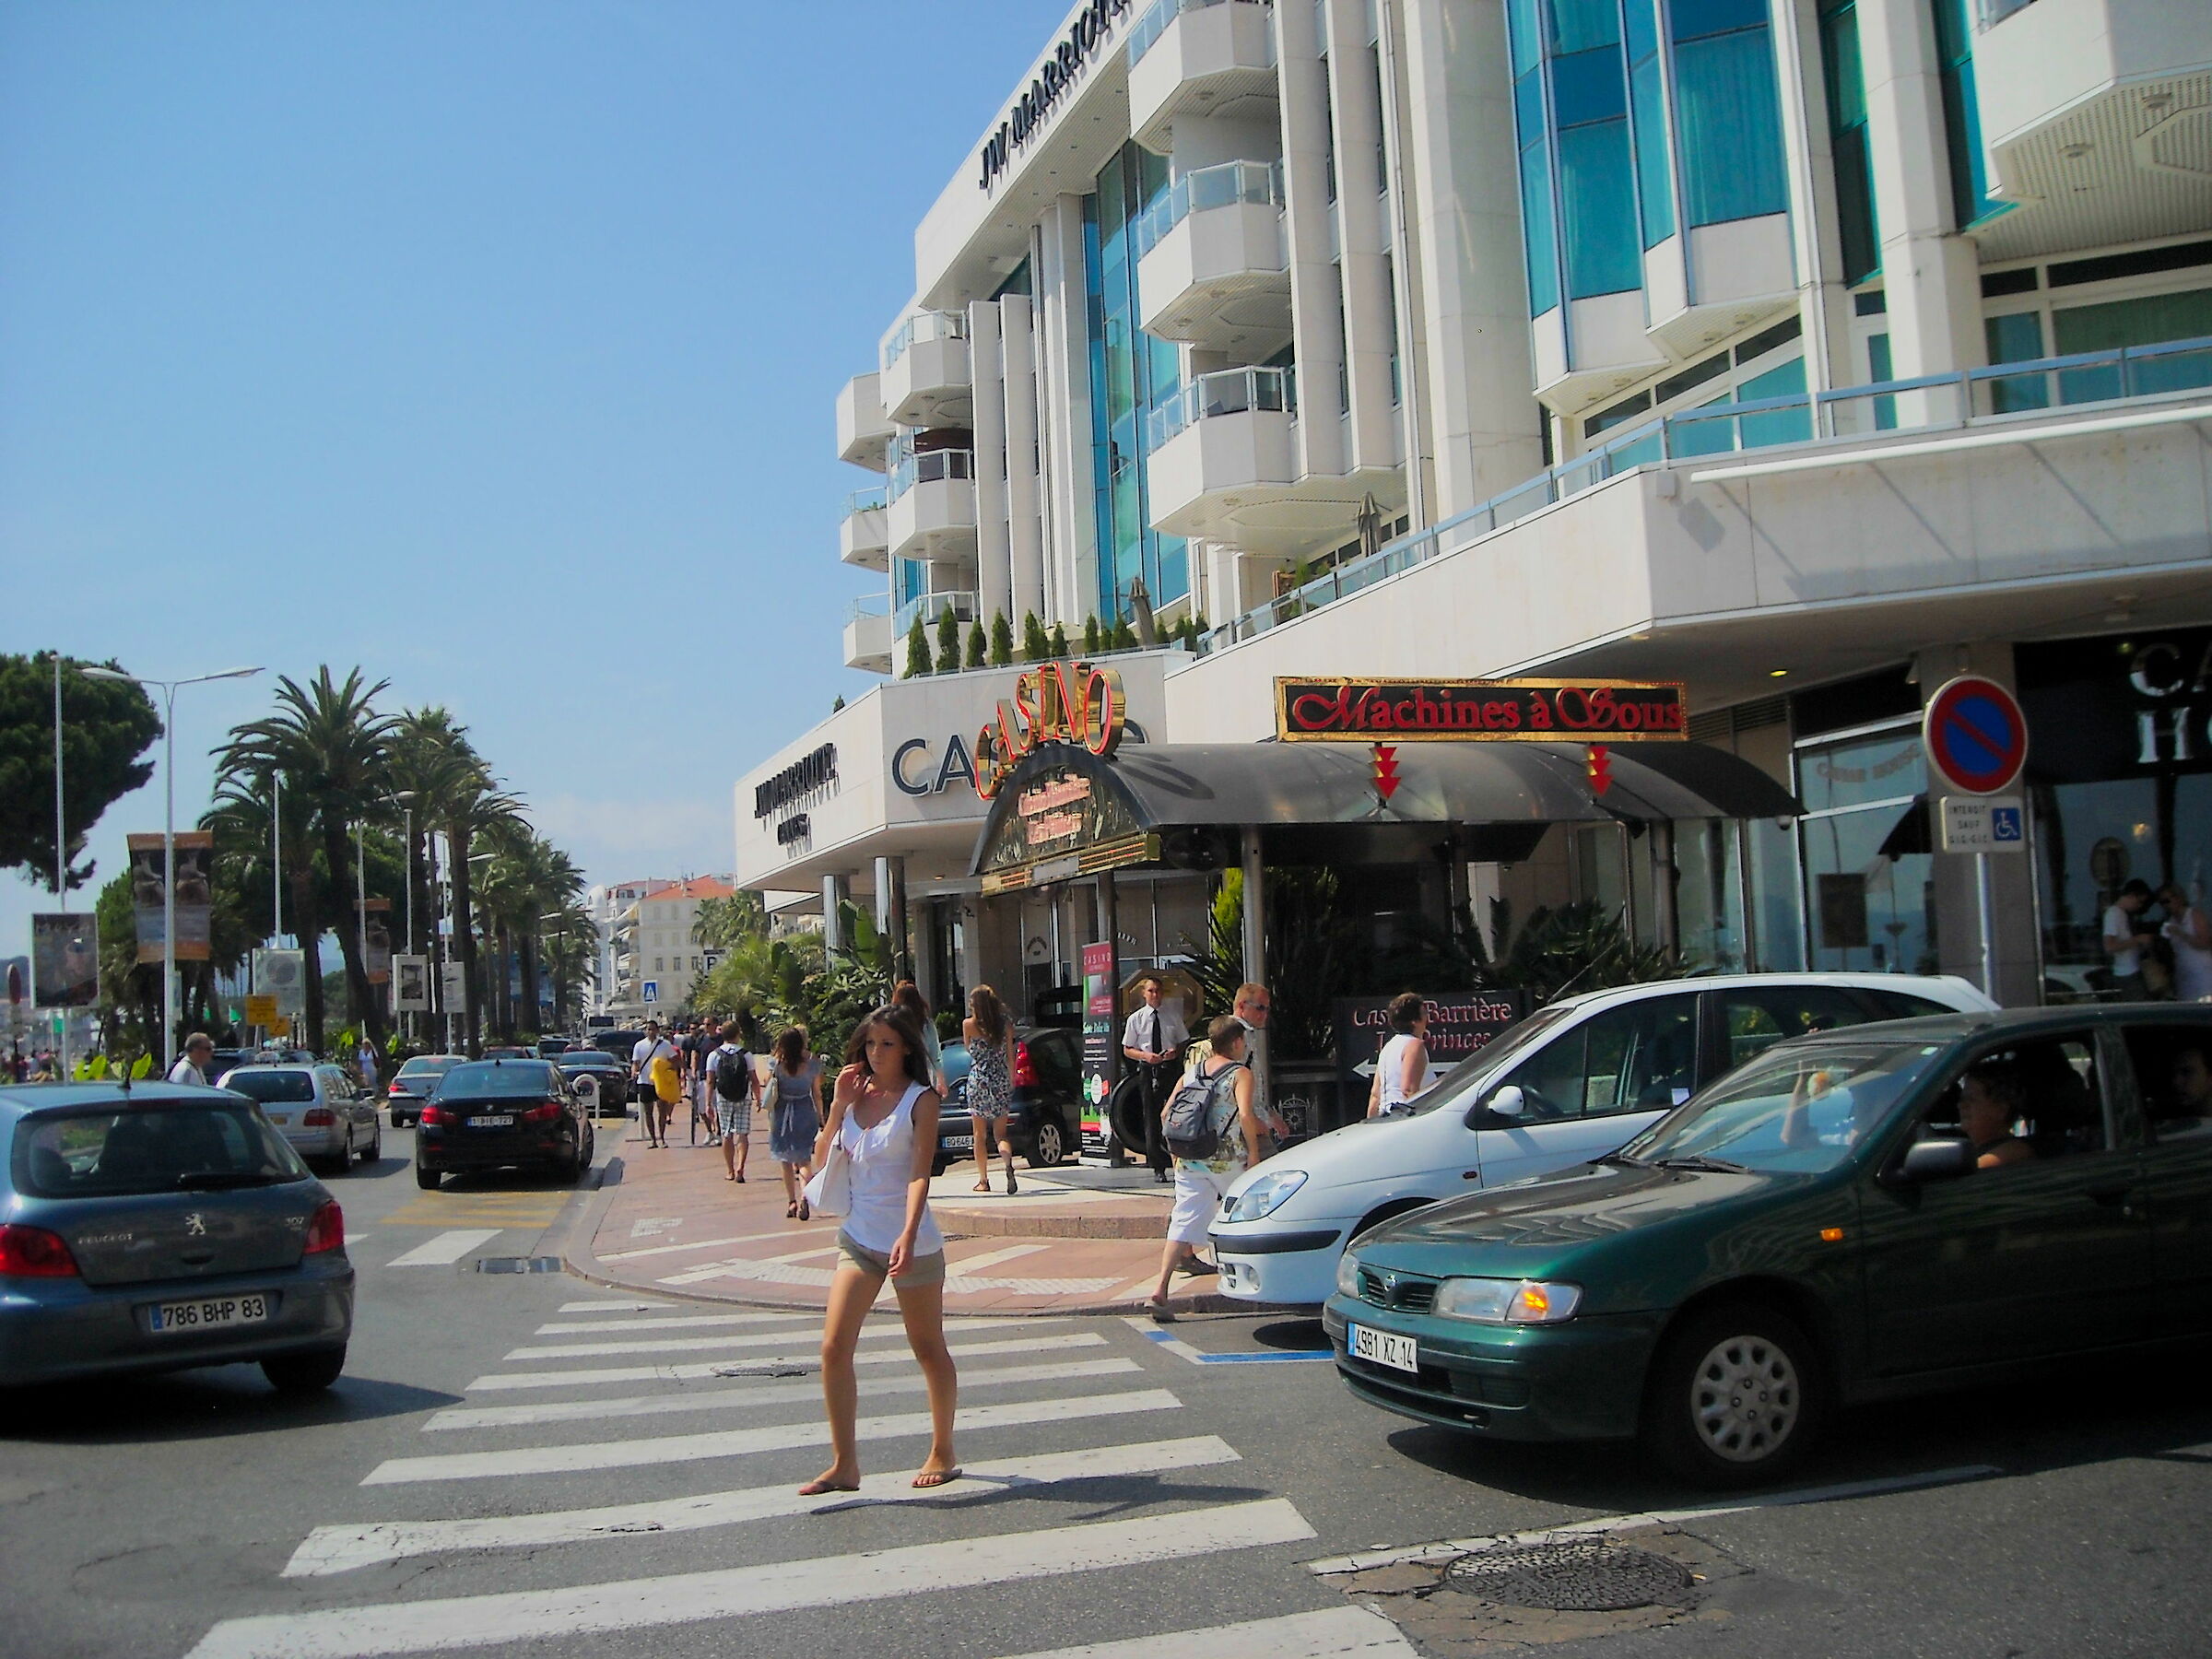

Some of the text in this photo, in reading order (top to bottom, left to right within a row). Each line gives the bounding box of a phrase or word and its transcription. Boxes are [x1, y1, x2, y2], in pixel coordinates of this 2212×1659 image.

[979, 122, 1008, 190] JW
[1292, 685, 1685, 731] Machines à Sous
[973, 661, 1126, 801] CASINO
[1083, 951, 1112, 967] CASINO
[1423, 996, 1512, 1025] Barrière
[162, 1298, 265, 1327] 786 BHP 83
[1355, 1328, 1414, 1369] 4981 XZ 14
